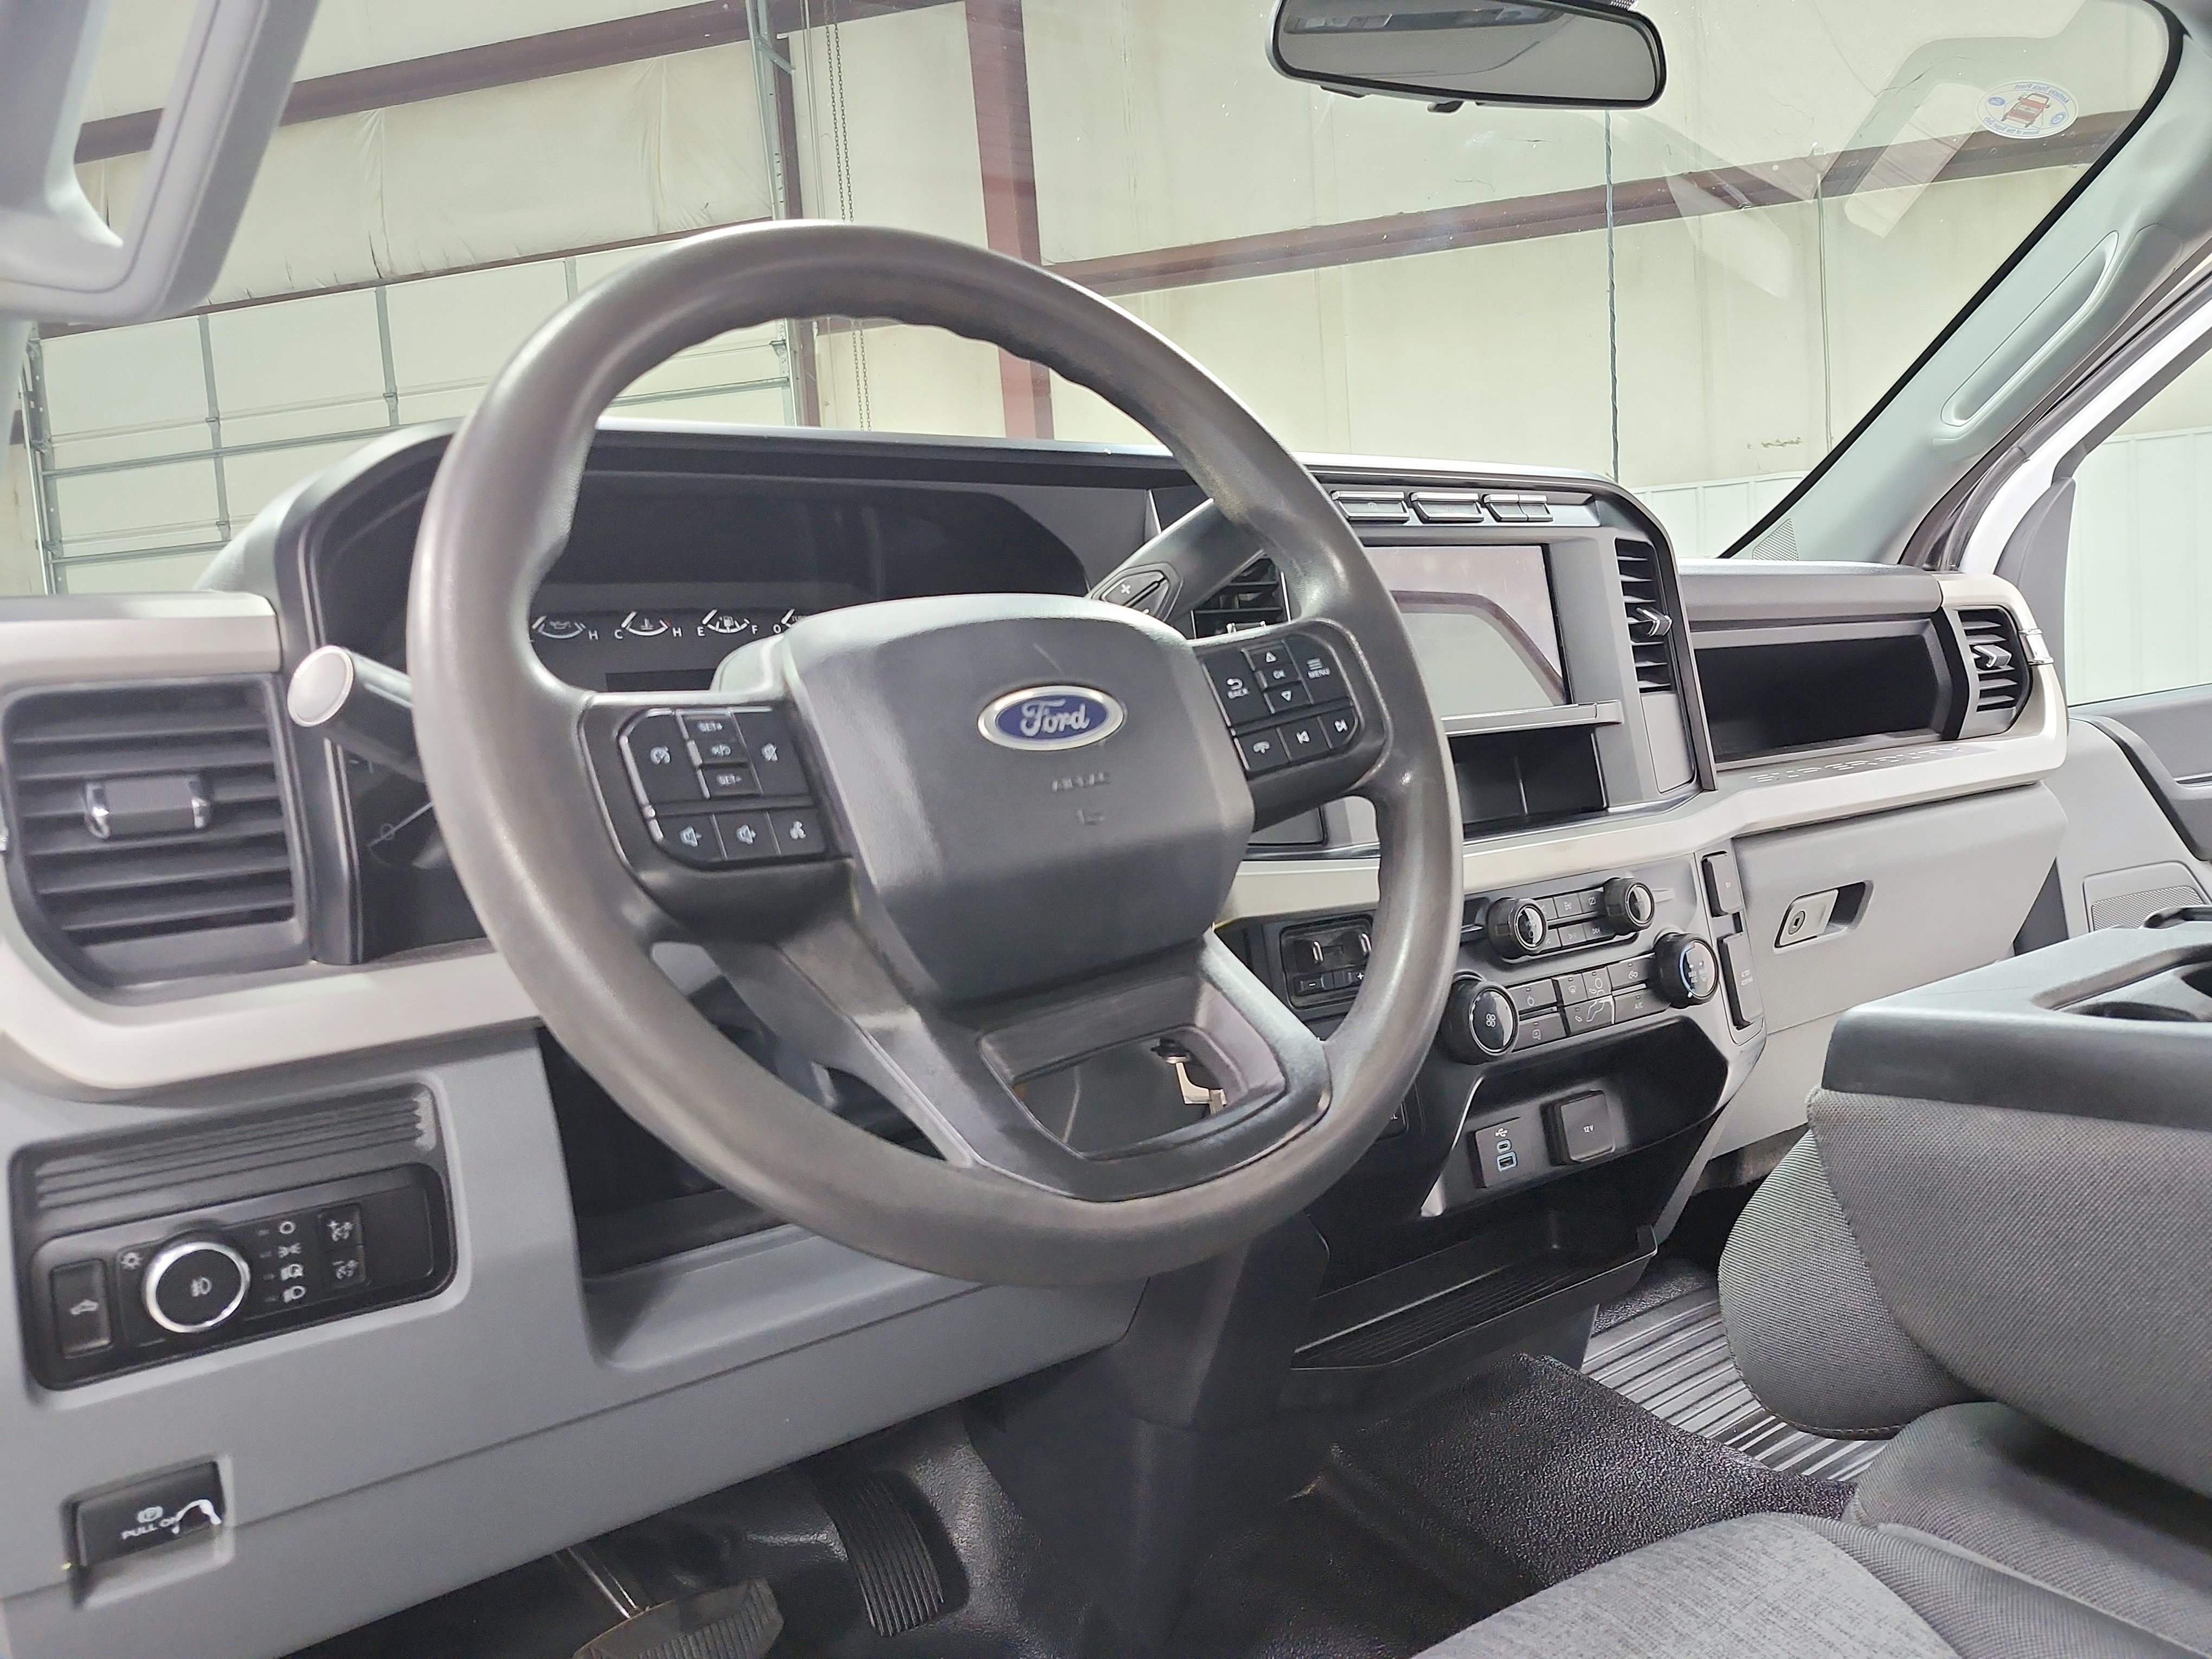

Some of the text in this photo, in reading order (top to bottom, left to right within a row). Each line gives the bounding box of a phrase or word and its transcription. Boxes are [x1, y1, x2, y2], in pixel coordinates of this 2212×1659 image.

[588, 630, 599, 640] H
[614, 627, 682, 639] C H
[697, 625, 758, 636] E F
[1307, 667, 1330, 679] MENU
[1020, 698, 1090, 737] Ford
[1583, 1124, 1593, 1133] 12V
